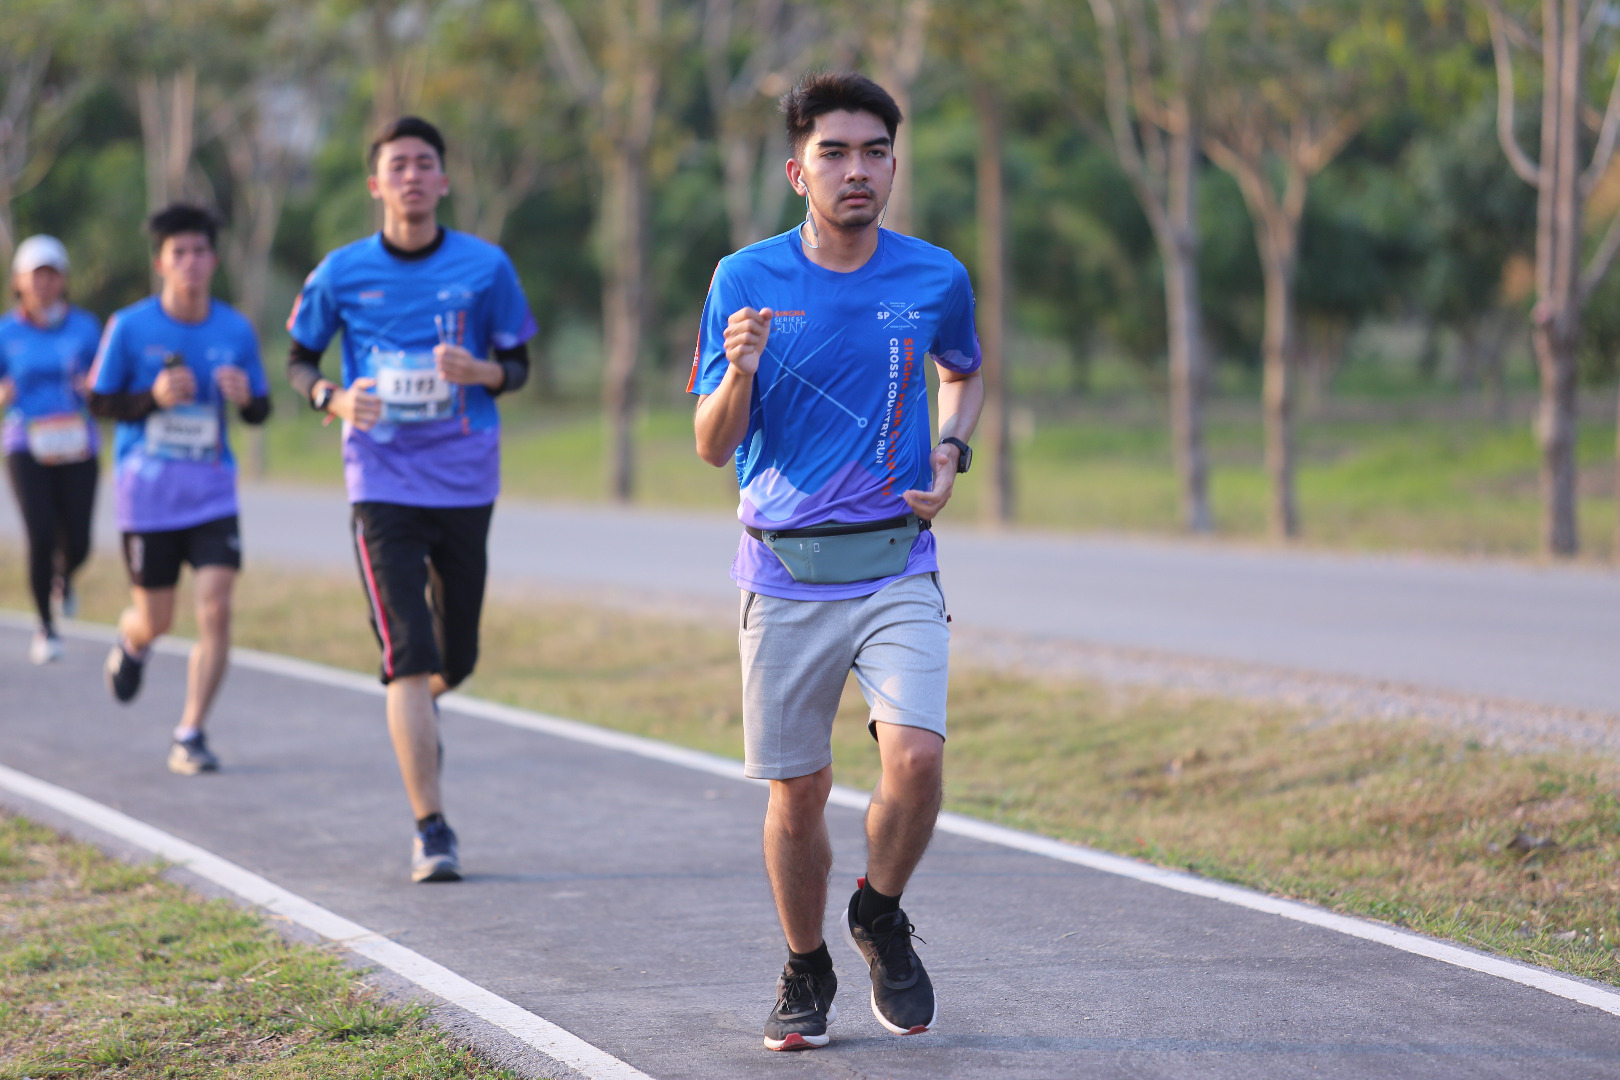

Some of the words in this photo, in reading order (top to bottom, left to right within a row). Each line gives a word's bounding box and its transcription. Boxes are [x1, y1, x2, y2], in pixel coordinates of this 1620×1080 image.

[877, 311, 890, 320] SP
[908, 311, 920, 320] XC
[889, 337, 899, 379] CROSS
[901, 338, 914, 390] SINGHA
[892, 393, 905, 427] PARK
[875, 440, 886, 464] RUN
